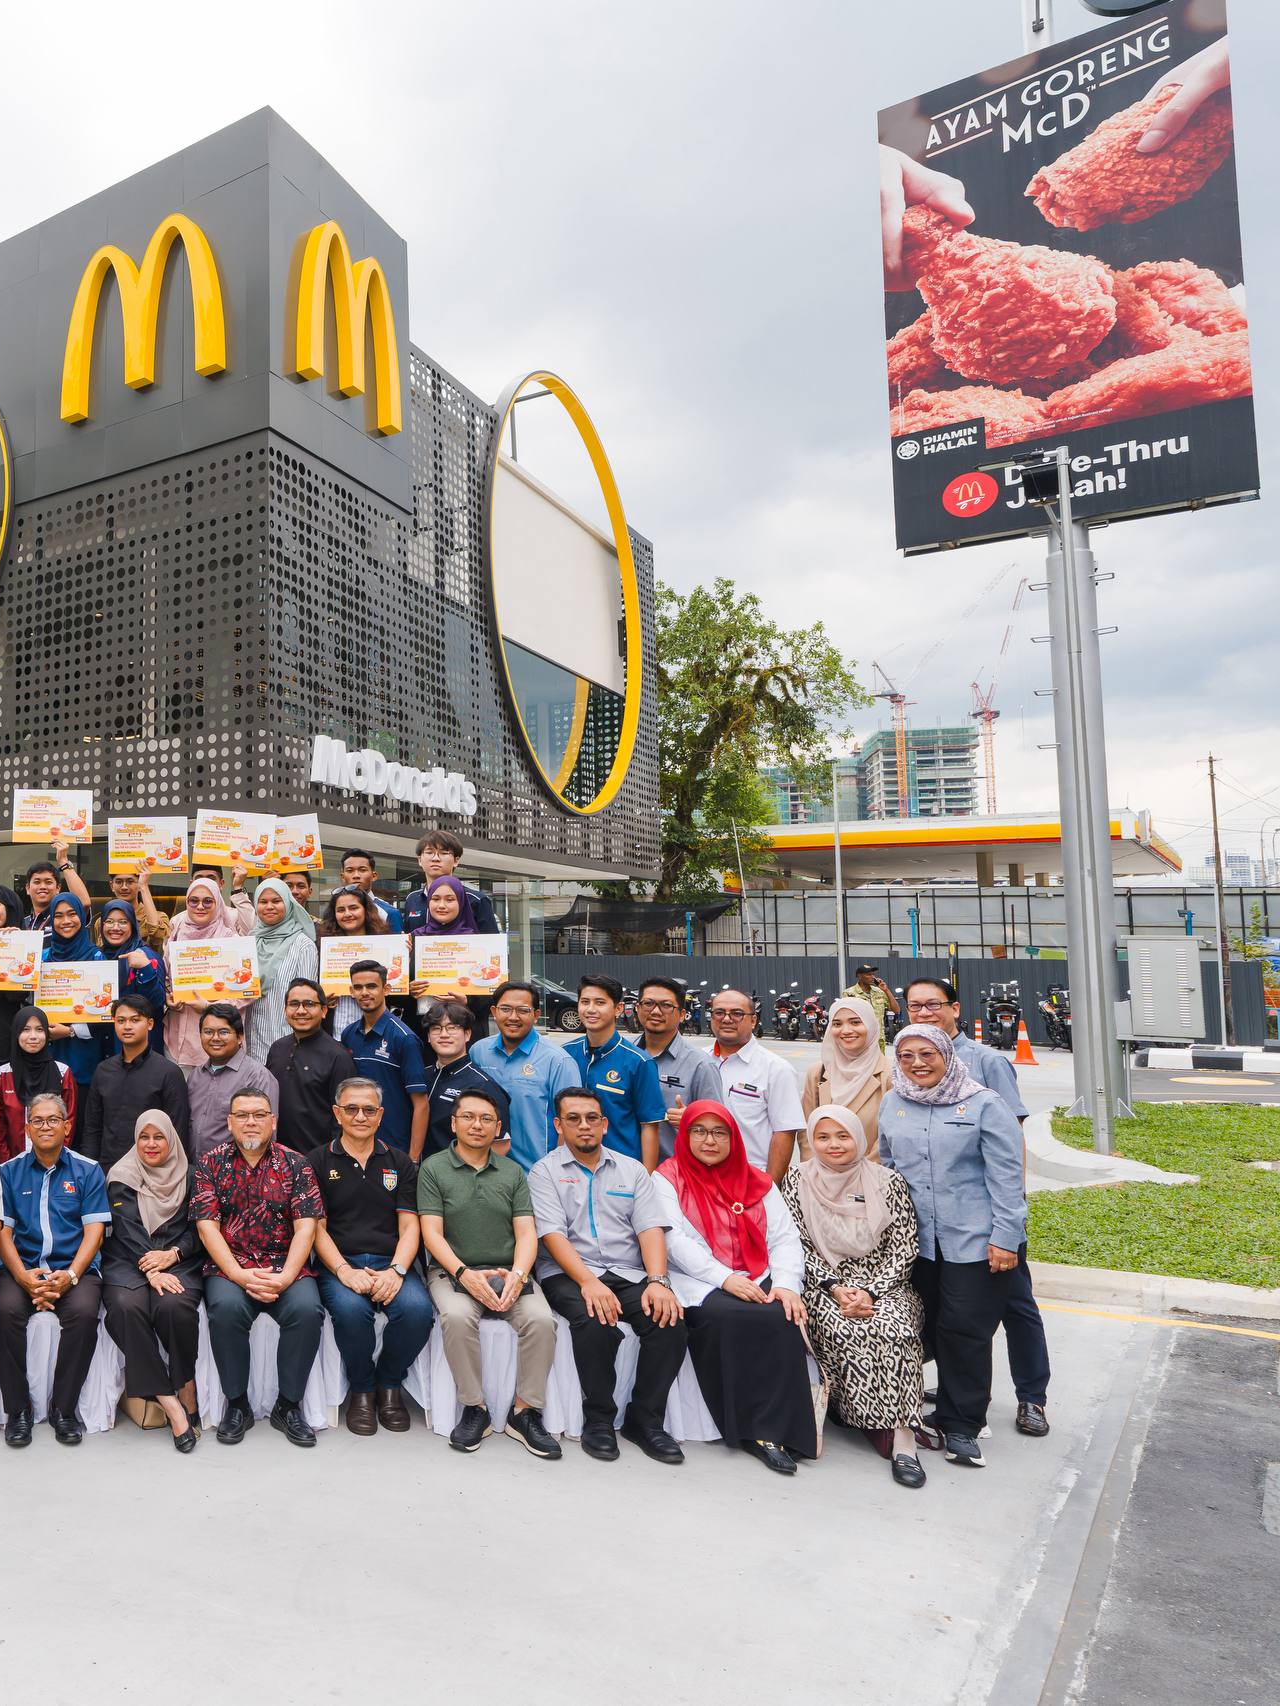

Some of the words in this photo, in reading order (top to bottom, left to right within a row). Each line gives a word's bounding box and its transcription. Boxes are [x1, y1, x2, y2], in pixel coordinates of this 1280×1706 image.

[925, 92, 1008, 150] AYAM
[1020, 23, 1171, 106] GORENG
[922, 425, 978, 446] DIJAMIN
[923, 436, 978, 456] HALAL
[1004, 435, 1190, 487] De-Thru
